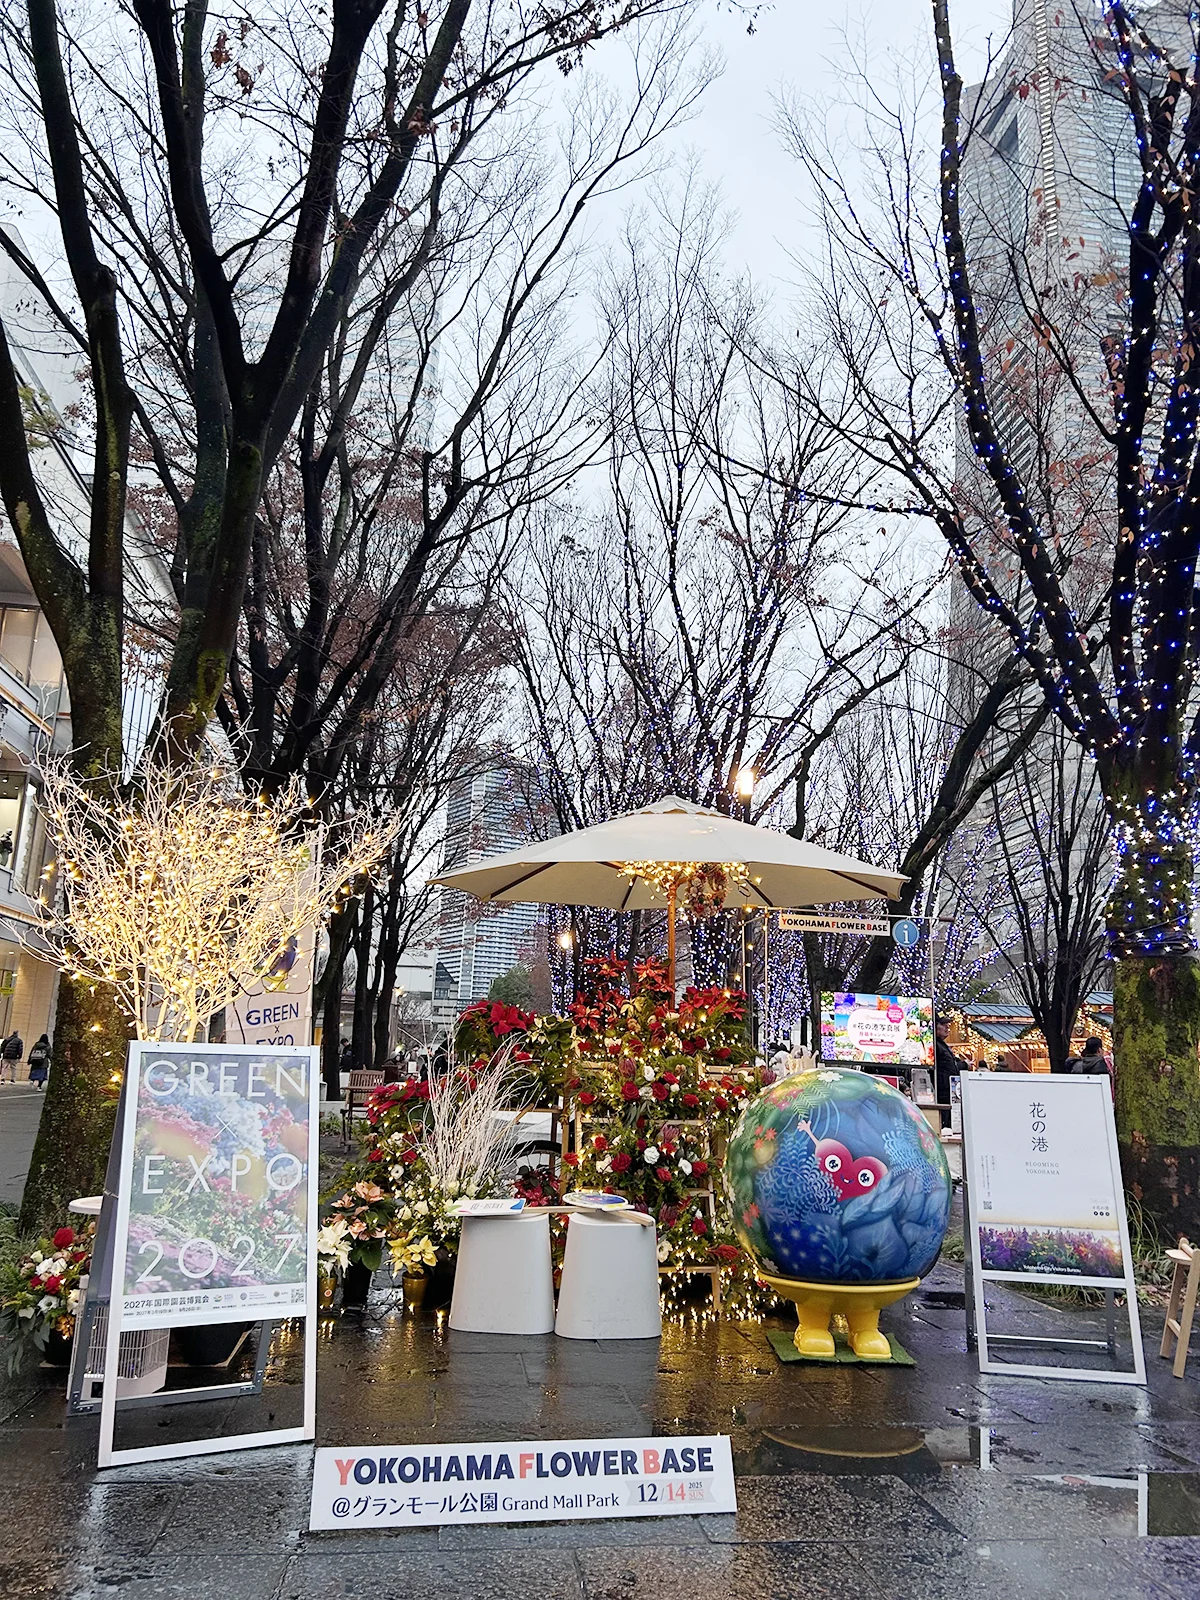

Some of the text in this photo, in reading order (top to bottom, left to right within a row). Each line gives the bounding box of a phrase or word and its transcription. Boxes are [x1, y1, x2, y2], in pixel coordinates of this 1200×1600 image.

[782, 918, 888, 932] YOKOHAMA FLOWER BASE
[246, 1002, 299, 1025] GREEN
[256, 1034, 294, 1046] XPO
[143, 1059, 306, 1098] GREEN
[1029, 1101, 1049, 1153] 花の港
[142, 1153, 303, 1194] EXPO
[135, 1233, 302, 1283] 2027
[123, 1294, 210, 1310] 2027年国際園芸博覧会
[334, 1447, 714, 1485] YOKOHAMA FLOWER BASE
[332, 1481, 687, 1518] @グランモール公園 Grand Mall Park 12/14
[688, 1481, 703, 1489] 2025
[688, 1491, 704, 1500] SUN
